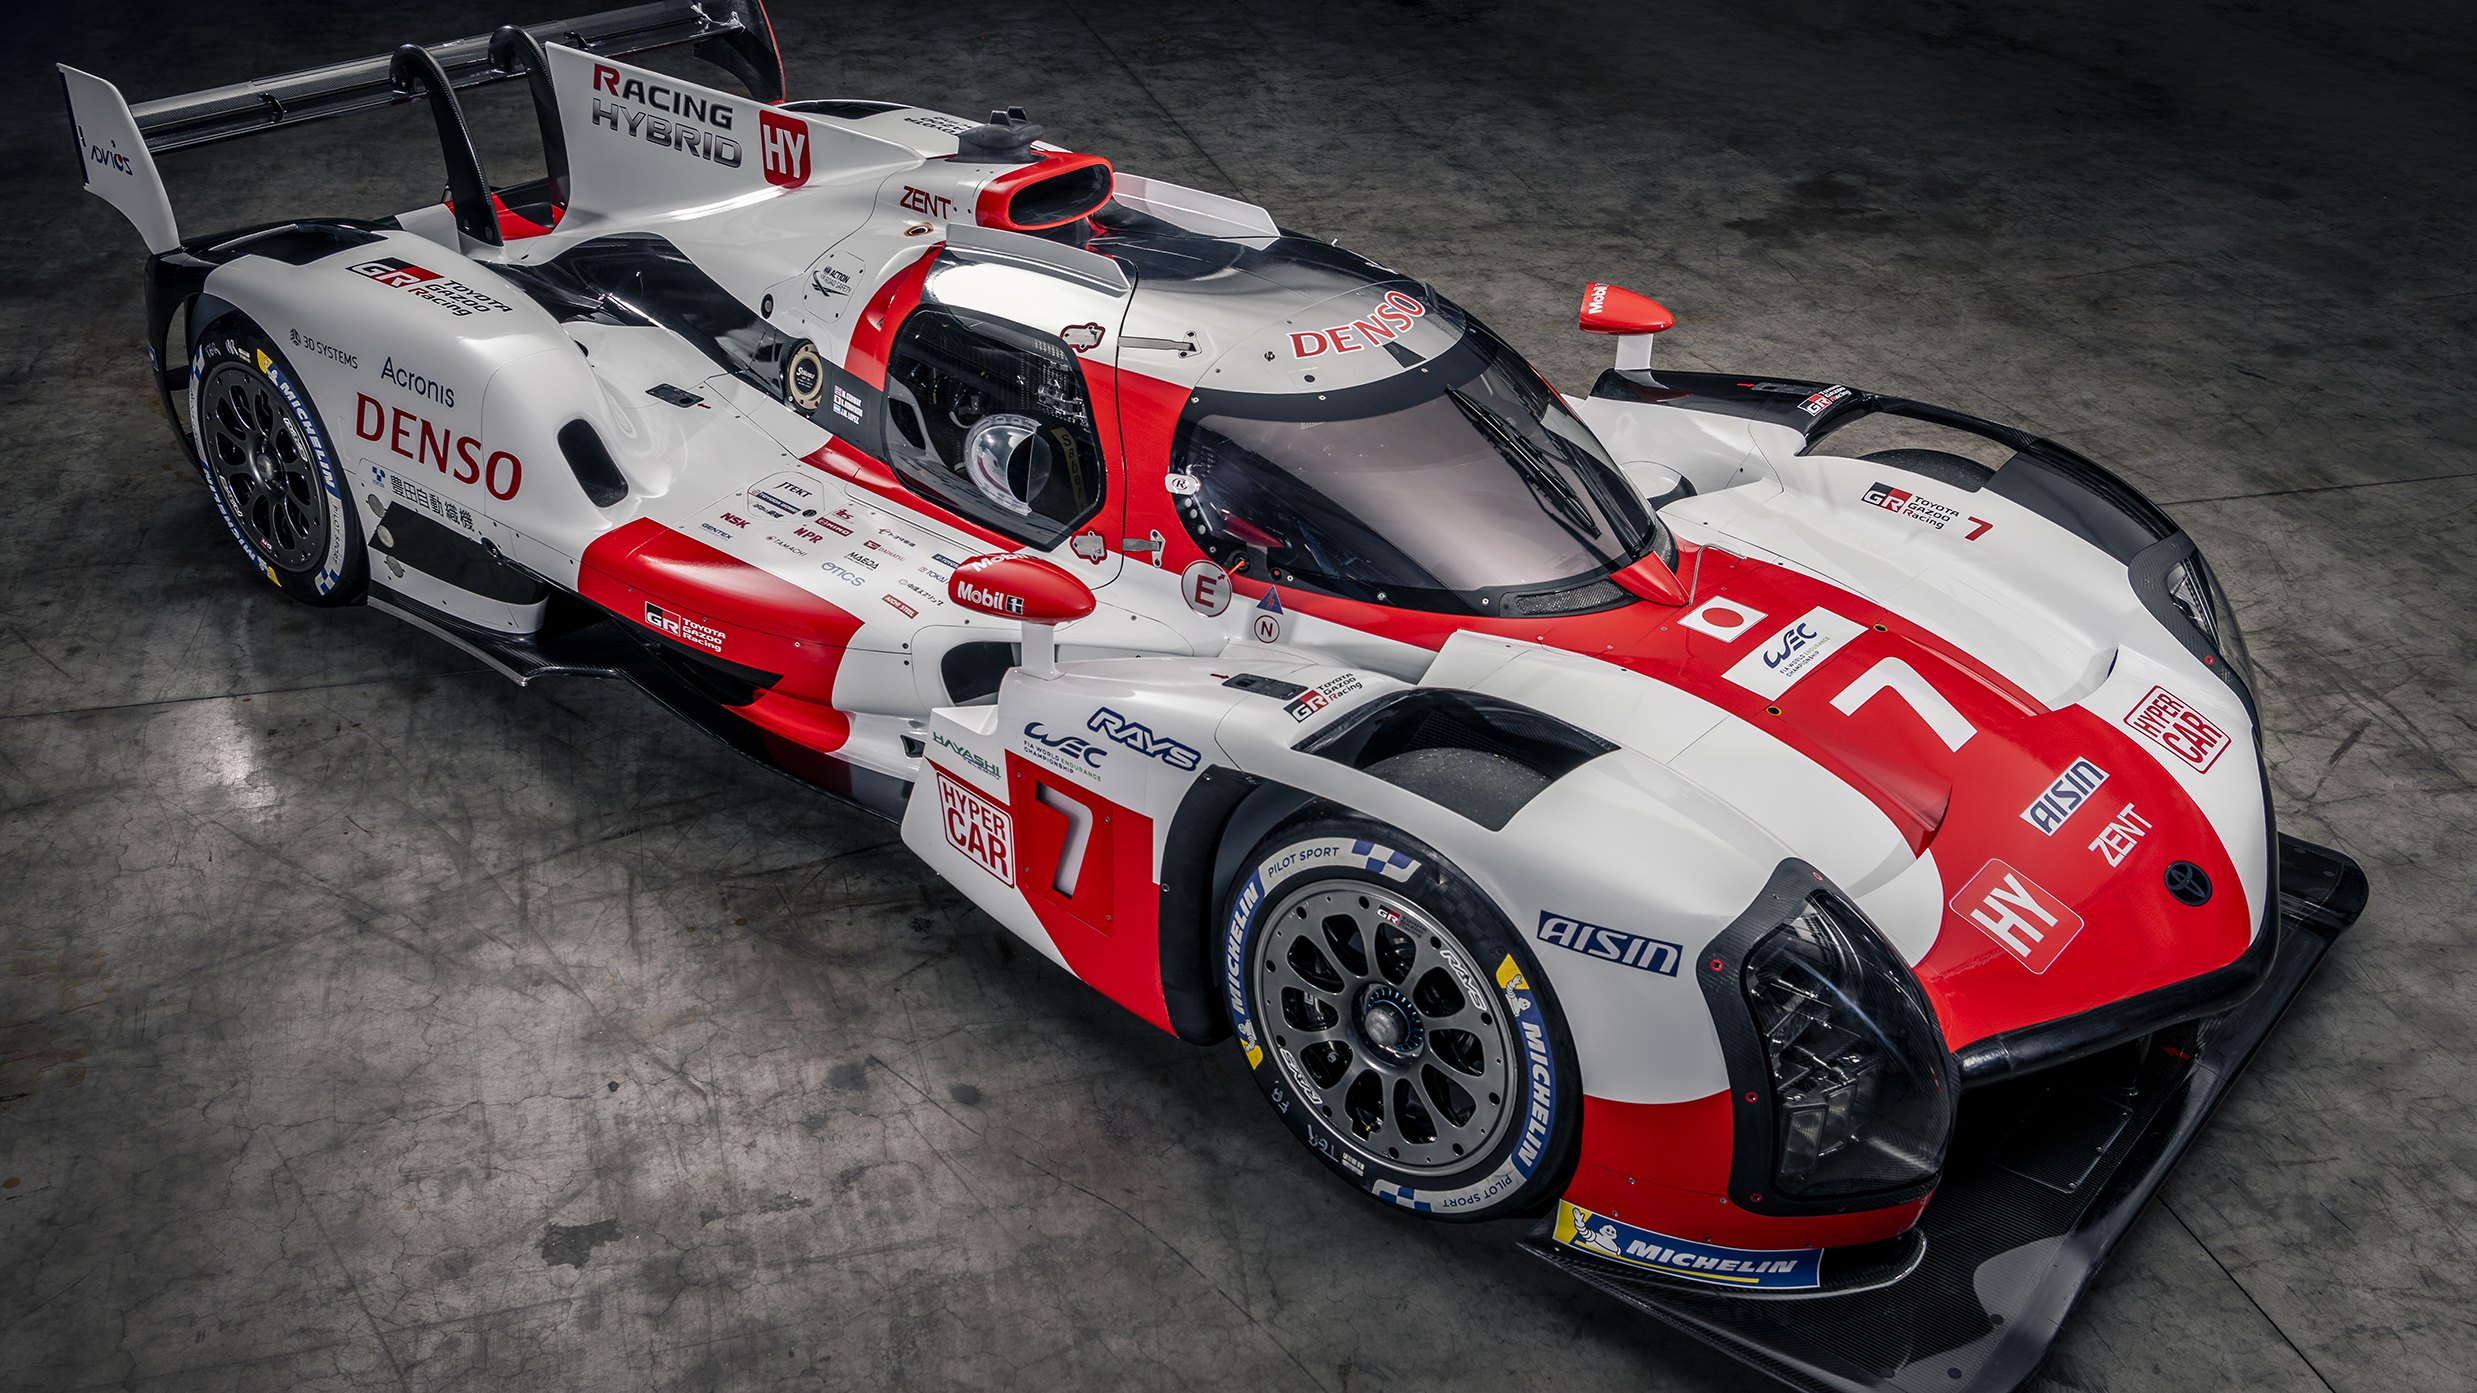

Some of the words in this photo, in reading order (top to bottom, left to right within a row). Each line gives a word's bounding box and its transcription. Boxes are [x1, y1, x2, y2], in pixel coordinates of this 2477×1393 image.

[593, 62, 734, 131] RACING
[592, 97, 743, 169] HYBRID
[762, 124, 805, 179] HY
[900, 185, 951, 220] ZENT
[352, 262, 421, 288] GR
[829, 269, 851, 284] ACTION
[407, 287, 473, 317] Racing
[424, 283, 491, 313] GAZOO
[443, 279, 514, 313] TOYOTA
[1288, 290, 1426, 360] DENSO
[303, 335, 315, 351] 3D
[316, 341, 358, 370] SYSTEMS
[380, 356, 455, 409] Acronis
[1807, 397, 1831, 414] GR
[279, 382, 336, 489] MICHELIN
[355, 391, 523, 501] DENSO
[772, 481, 813, 498] JTEKT
[1863, 489, 1905, 512] GR
[203, 466, 257, 561] MICHELIN
[720, 512, 751, 530] NSK
[1902, 508, 1945, 531] Racing
[1907, 502, 1951, 523] GAZOO
[1914, 495, 1960, 518] TOYOTA
[701, 522, 733, 540] GENTEX
[793, 527, 824, 544] NPR
[827, 521, 850, 535] HINO
[1964, 515, 1994, 542] 7
[773, 538, 808, 557] TAMACHI
[847, 551, 880, 570] MAEDA
[879, 546, 906, 562] DAIHATSU
[821, 562, 866, 587] OTICS
[971, 553, 1029, 573] Mobil
[957, 580, 1005, 611] Mobil
[1194, 573, 1217, 609] E
[884, 596, 901, 607] AICHI
[900, 604, 915, 617] STEEL
[646, 611, 679, 635] GR
[682, 617, 726, 640] TOYOTA
[682, 625, 723, 645] GAZOO
[1261, 620, 1273, 638] N
[682, 631, 722, 653] Racing
[1763, 622, 1818, 669] WEC
[1316, 672, 1354, 691] TOYOTA
[1323, 677, 1356, 696] GAZOO
[1328, 681, 1363, 702] Racing
[1291, 695, 1328, 720] GR
[1829, 656, 1978, 753] 7
[2133, 693, 2185, 738] HYPER
[1023, 722, 1108, 769] WEC
[1087, 706, 1201, 771] RAYS
[2162, 710, 2223, 764] CAR
[932, 730, 1001, 777] HAYASHI
[1023, 746, 1074, 774] CHAMPIONSHIP
[1023, 740, 1035, 749] FIA
[1035, 745, 1060, 762] WORLD
[1060, 757, 1102, 782] ENDURANCE
[942, 780, 1006, 841] HYPER
[2029, 760, 2105, 834] AISIN
[946, 806, 1009, 880] CAR
[1035, 779, 1094, 900] 7
[2088, 802, 2153, 868] ZENT
[1267, 853, 1297, 878] PILOT
[1299, 846, 1340, 861] SPORT
[1376, 907, 1399, 925] GR
[1969, 872, 2059, 959] HY
[1227, 881, 1260, 1016] MICHELIN
[1538, 917, 1679, 974] AISIN
[1440, 949, 1487, 1012] RAYS
[1521, 1021, 1550, 1168] MICHELIN
[1441, 1194, 1482, 1208] SPORT
[1483, 1174, 1513, 1199] PILOT
[1625, 1238, 1798, 1274] MICHELIN
